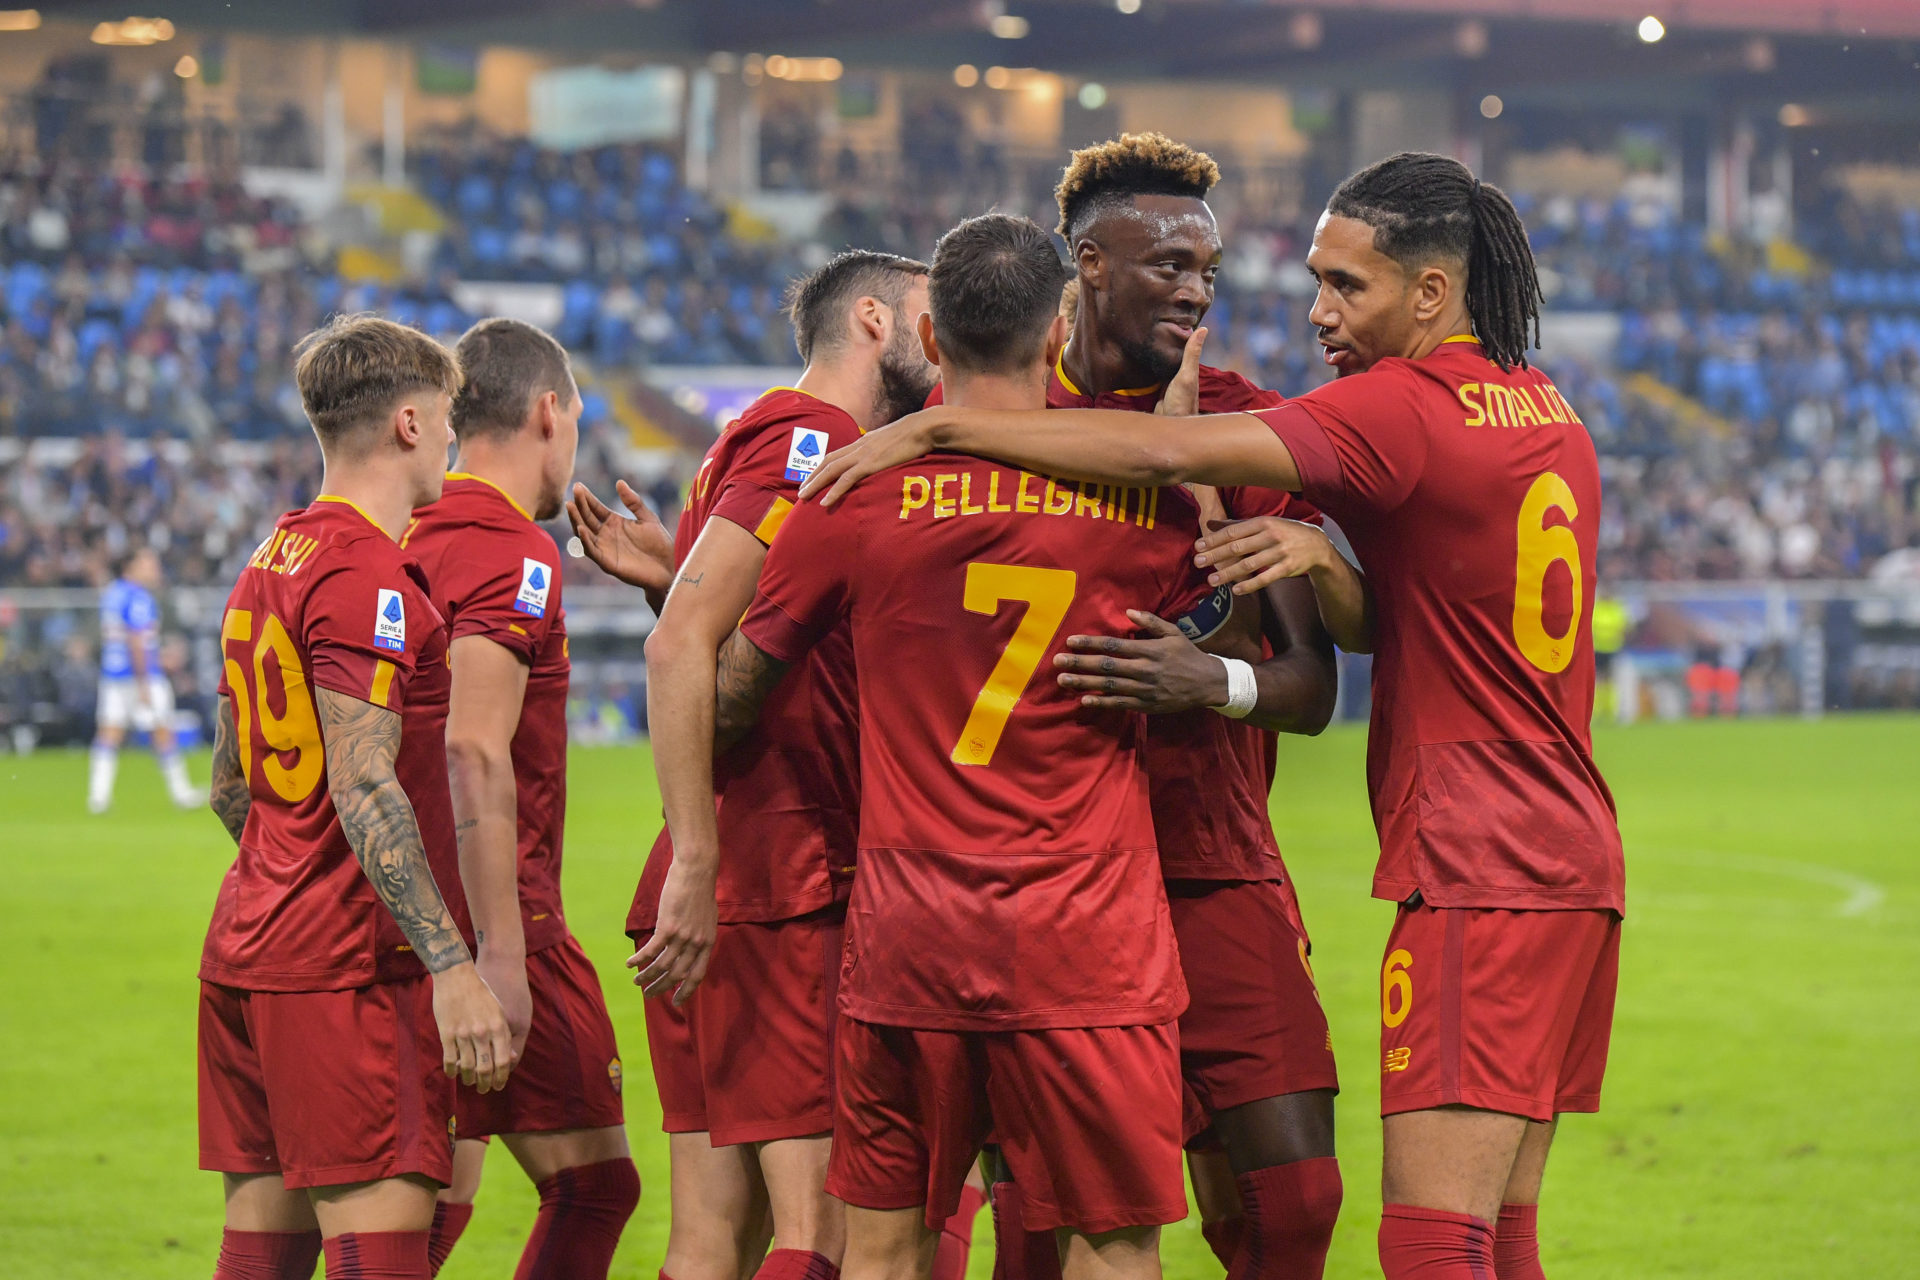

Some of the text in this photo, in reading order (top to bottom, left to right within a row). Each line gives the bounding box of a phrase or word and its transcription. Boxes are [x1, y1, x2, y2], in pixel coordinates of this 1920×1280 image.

[1458, 383, 1583, 428] SMALLIN
[792, 457, 812, 466] SERIE
[899, 471, 1158, 530] PELLEGRINI
[523, 589, 539, 600] SERIE
[1513, 471, 1582, 674] 6
[380, 624, 397, 633] SERIE
[527, 604, 542, 616] TIM
[387, 639, 402, 649] TIM
[951, 562, 1077, 766] 7
[221, 608, 324, 802] 59
[1383, 949, 1413, 1028] 6
